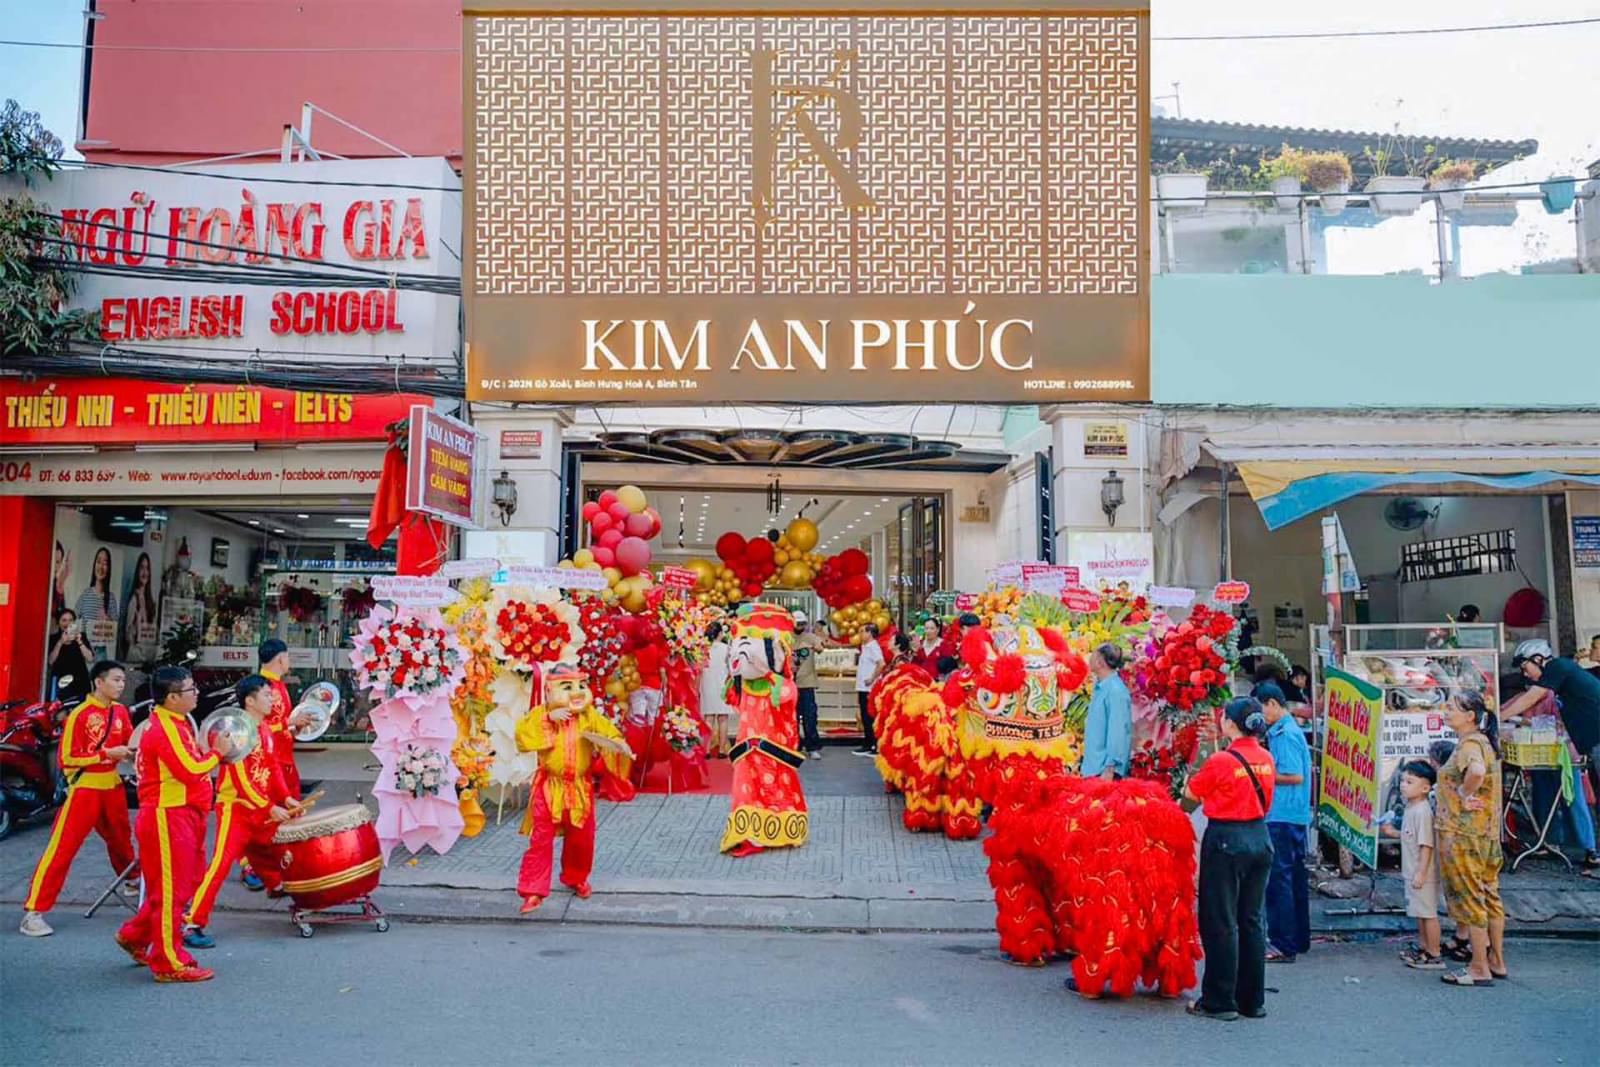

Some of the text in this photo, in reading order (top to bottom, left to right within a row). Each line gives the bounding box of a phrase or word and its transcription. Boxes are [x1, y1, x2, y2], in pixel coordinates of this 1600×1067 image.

[164, 188, 327, 268] HOÀNG
[343, 198, 428, 262] GIA
[101, 289, 405, 341] ENGLISH SCHOOL
[581, 300, 1033, 371] KIM AN PHÚC
[6, 383, 68, 428] THIẾU
[76, 395, 114, 427] NHI
[147, 384, 208, 426] THIẾU
[212, 384, 262, 425] NIÊN
[294, 391, 353, 423] IELTS
[1024, 380, 1066, 389] HOTLINE
[58, 469, 71, 482] 66
[75, 469, 94, 482] 833
[223, 651, 249, 660] IELTS
